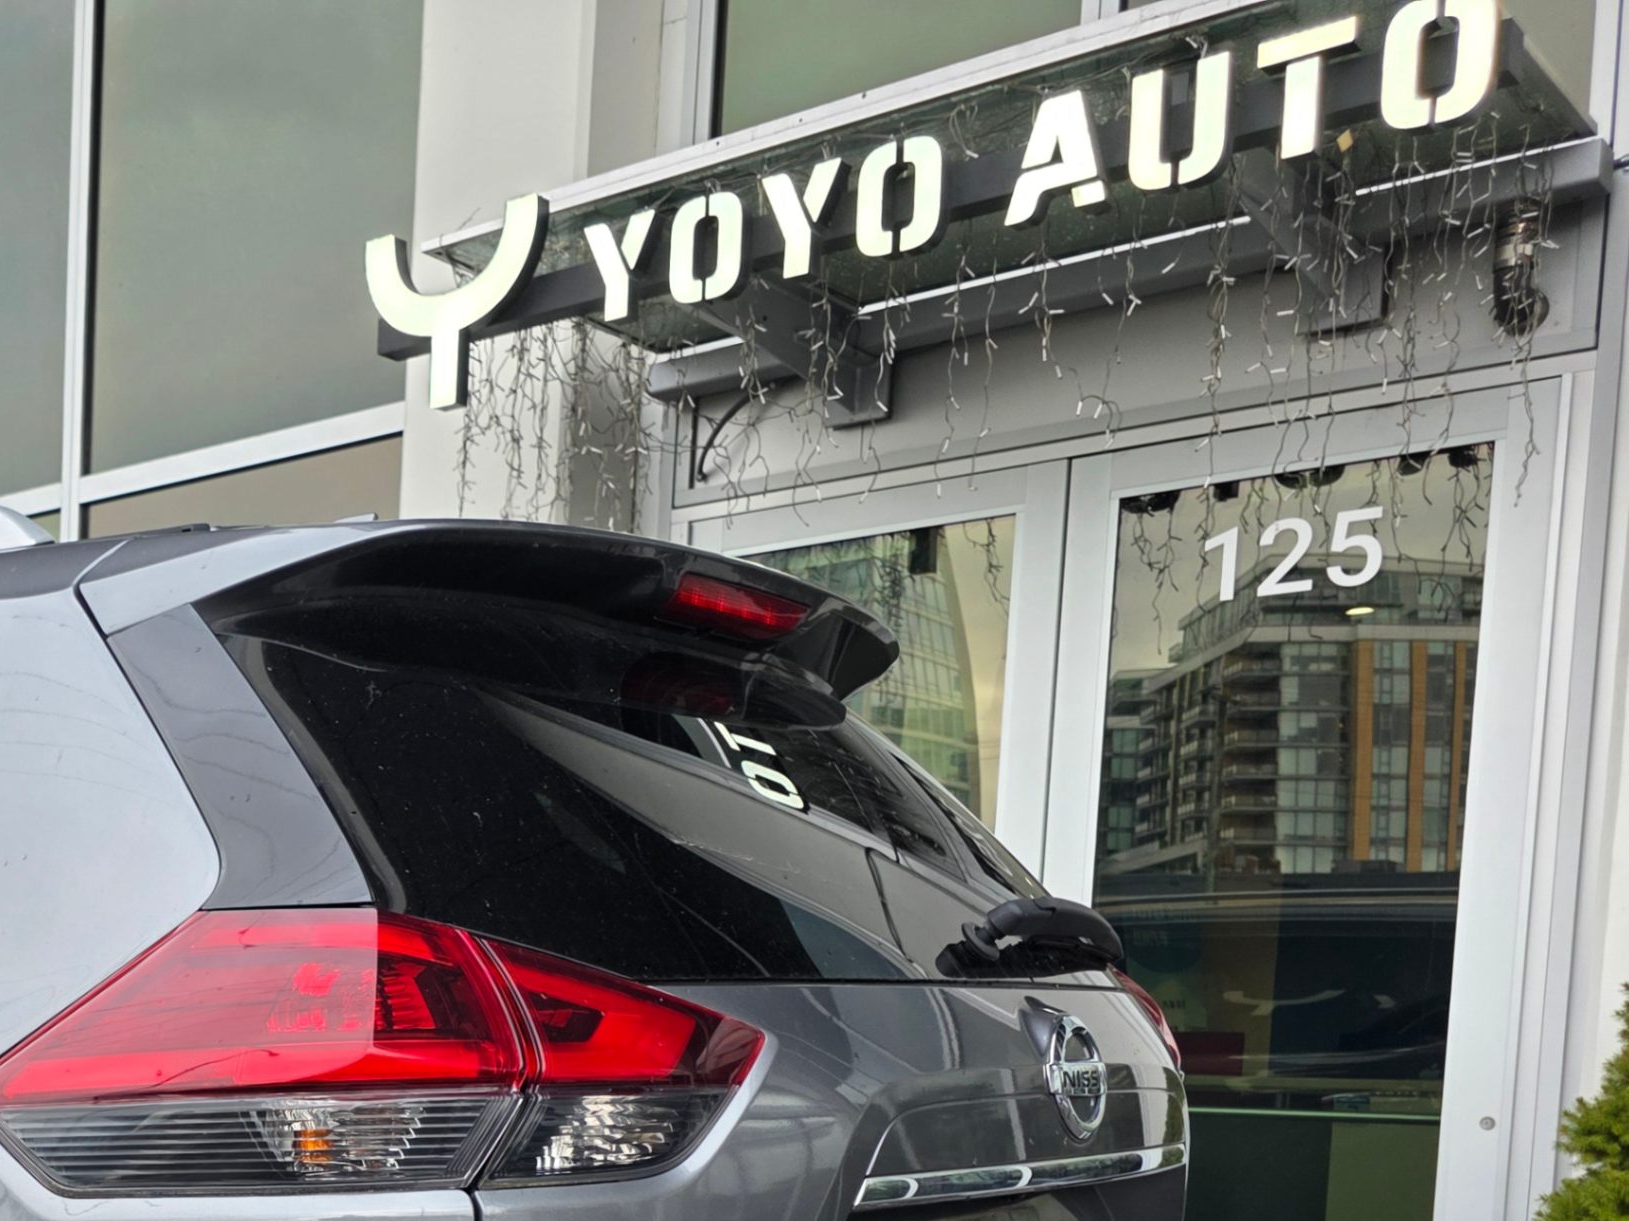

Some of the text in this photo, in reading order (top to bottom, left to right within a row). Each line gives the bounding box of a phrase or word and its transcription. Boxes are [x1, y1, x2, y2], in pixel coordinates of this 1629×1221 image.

[583, 0, 1500, 322] YOYO AUTO
[1204, 506, 1384, 602] 125
[1062, 1069, 1101, 1089] NISS
